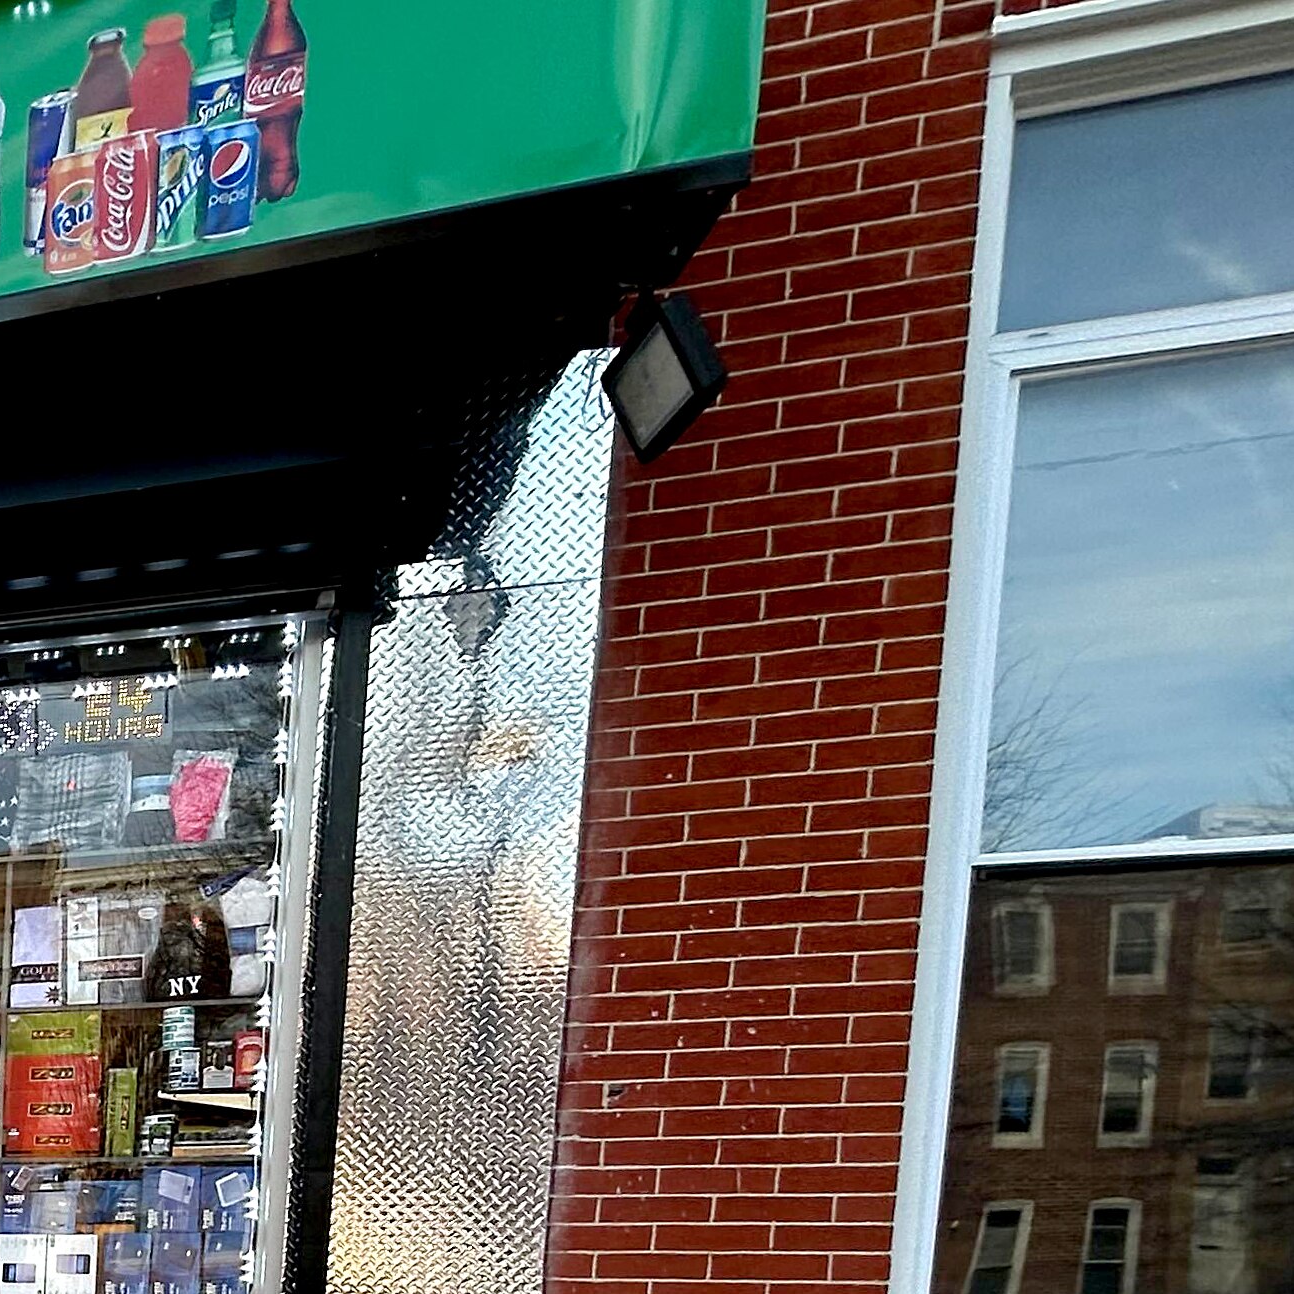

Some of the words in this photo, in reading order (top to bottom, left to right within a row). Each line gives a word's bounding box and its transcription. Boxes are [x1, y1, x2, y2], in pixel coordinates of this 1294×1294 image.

[197, 90, 238, 127] Sprite
[207, 187, 249, 208] pepsi
[51, 199, 93, 235] Fan
[63, 713, 164, 745] HOURS
[169, 975, 202, 997] NY
